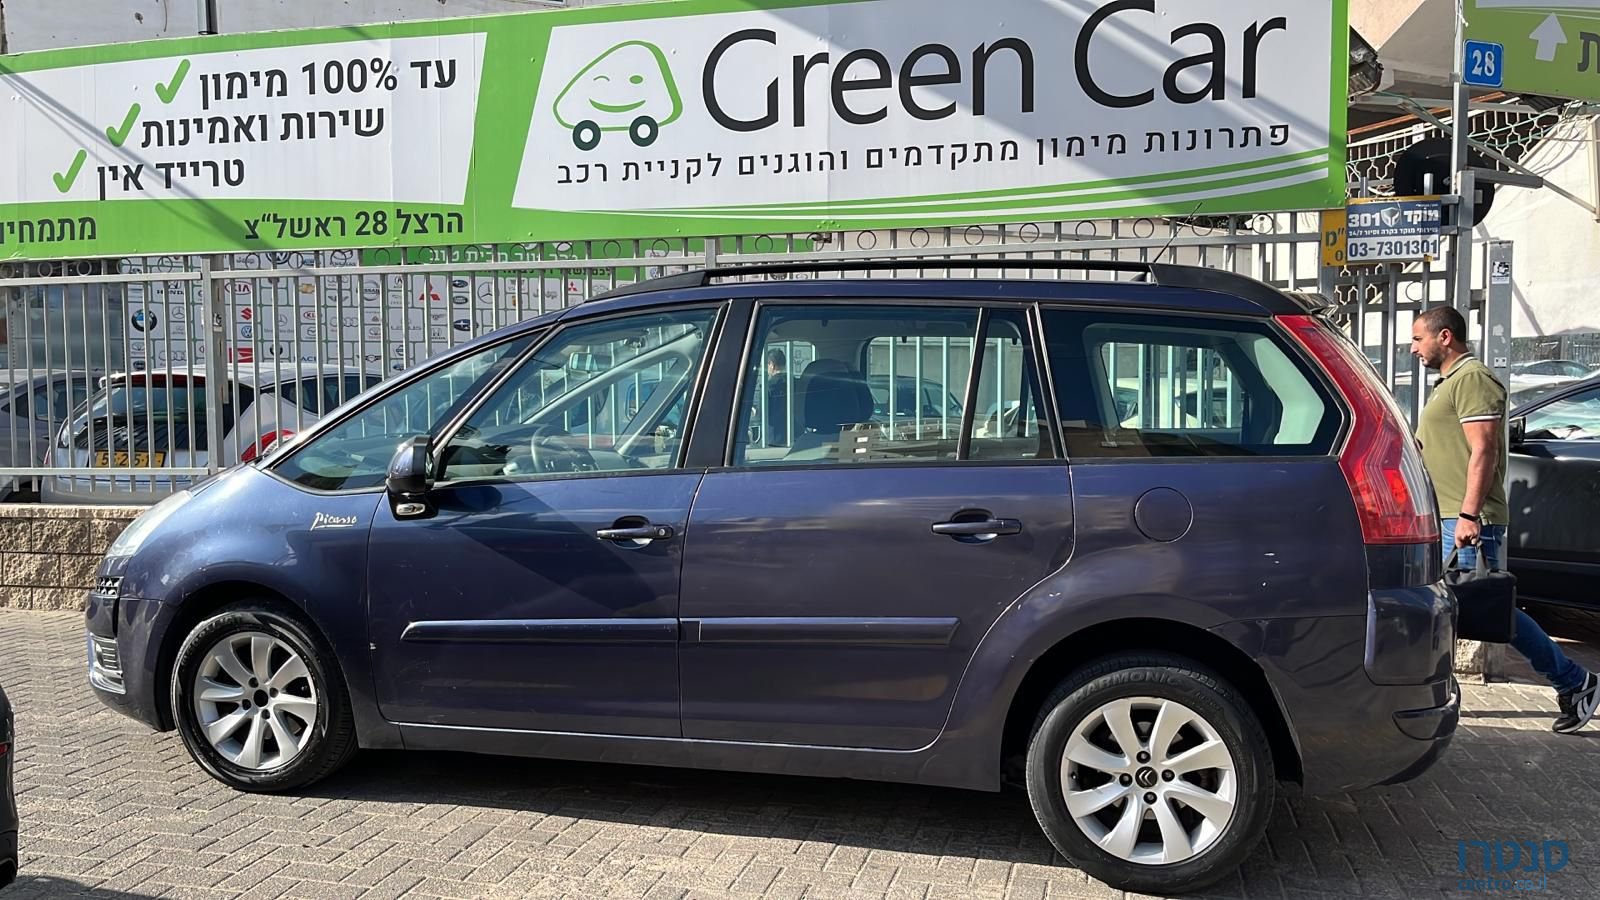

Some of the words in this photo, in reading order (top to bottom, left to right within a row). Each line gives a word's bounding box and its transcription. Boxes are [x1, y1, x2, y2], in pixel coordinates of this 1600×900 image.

[303, 58, 397, 94] 100%
[411, 60, 456, 88] עד
[703, 29, 1034, 131] Green
[1075, 0, 1287, 108] Car
[1471, 49, 1496, 77] 28
[200, 70, 287, 109] מימון
[142, 115, 268, 147] ואמינות
[281, 108, 384, 140] שירות
[1037, 134, 1125, 165] מימון
[1144, 125, 1289, 153] פתרונות
[623, 153, 721, 183] לקניית
[739, 151, 848, 176] והוגנים
[867, 141, 1018, 170] מתקדמים
[98, 164, 143, 201] אין
[156, 159, 244, 188] טרייד
[558, 164, 607, 183] רכב
[0, 217, 96, 245] מתמחי
[356, 211, 387, 235] 28
[397, 209, 463, 234] הרצל
[1348, 212, 1380, 227] 301
[1349, 240, 1438, 257] 03-7301301
[310, 512, 358, 531] Picasso
